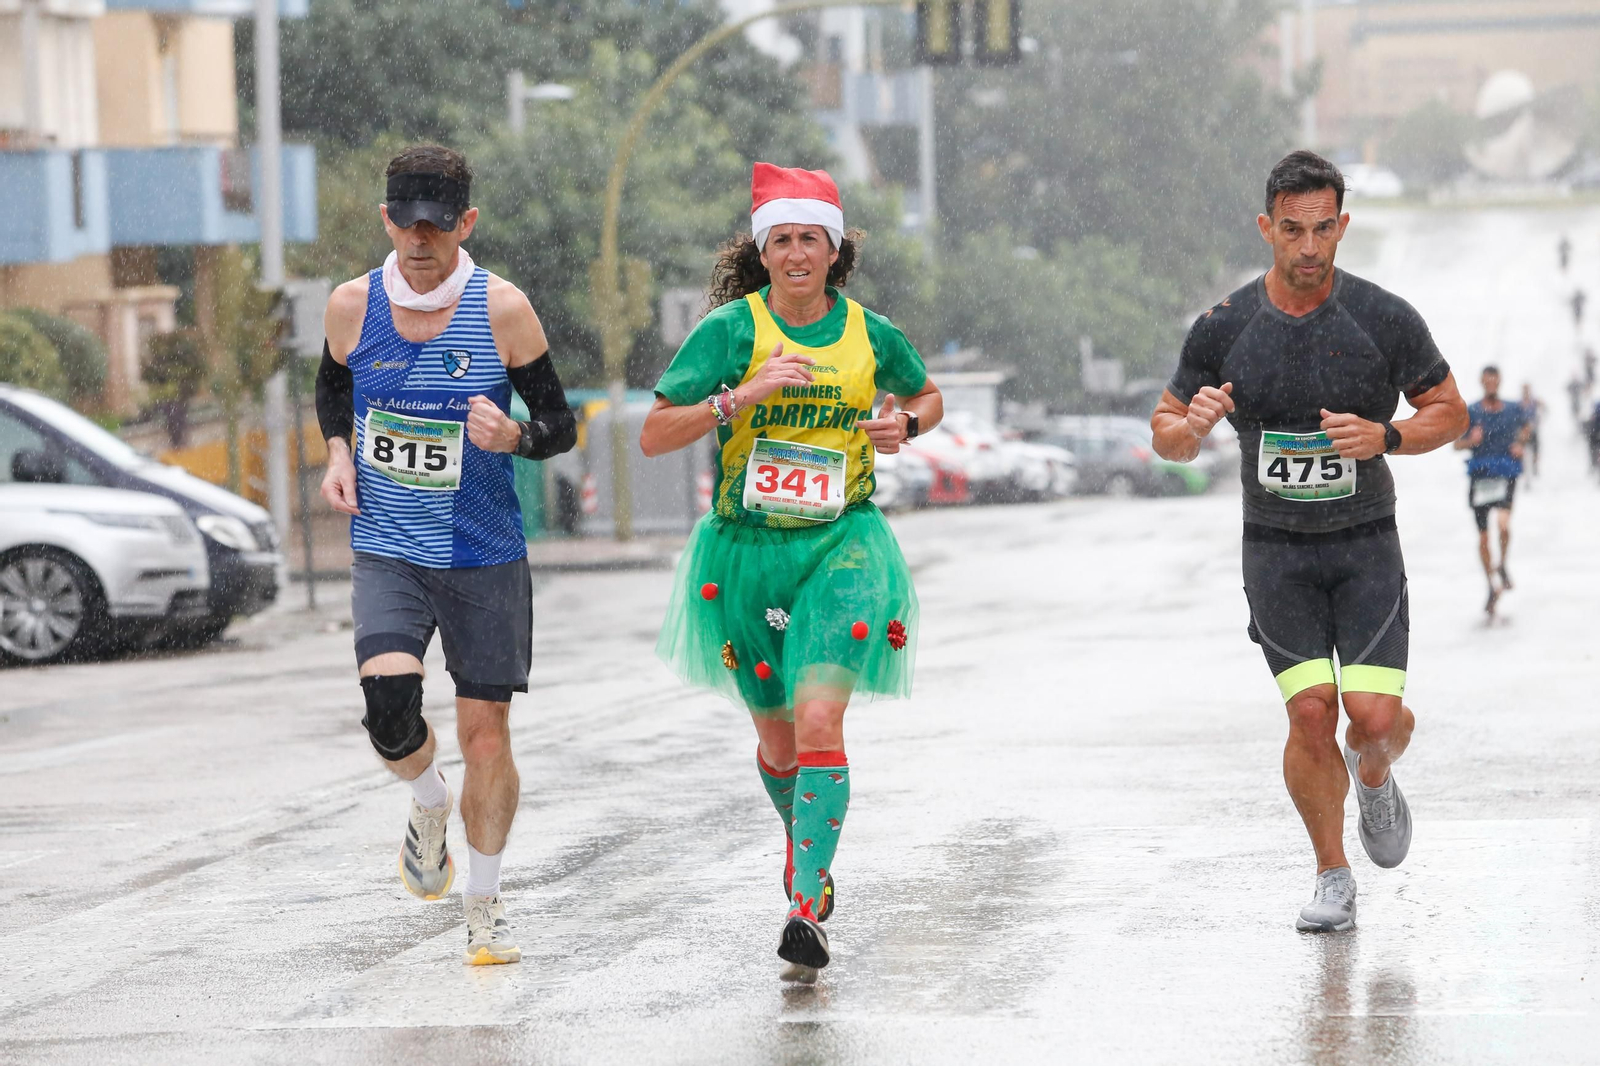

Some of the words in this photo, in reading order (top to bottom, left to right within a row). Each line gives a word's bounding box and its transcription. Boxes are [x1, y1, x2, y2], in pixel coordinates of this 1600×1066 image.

[782, 384, 842, 400] RUNNERS
[385, 397, 443, 411] Atletismo
[373, 435, 448, 472] 815
[1276, 439, 1305, 451] CARRERA
[1306, 438, 1334, 450] NAVIDA
[768, 446, 800, 461] CARRERA
[801, 451, 828, 467] NAVIDAD
[1267, 454, 1343, 483] 475
[755, 464, 830, 501] 341
